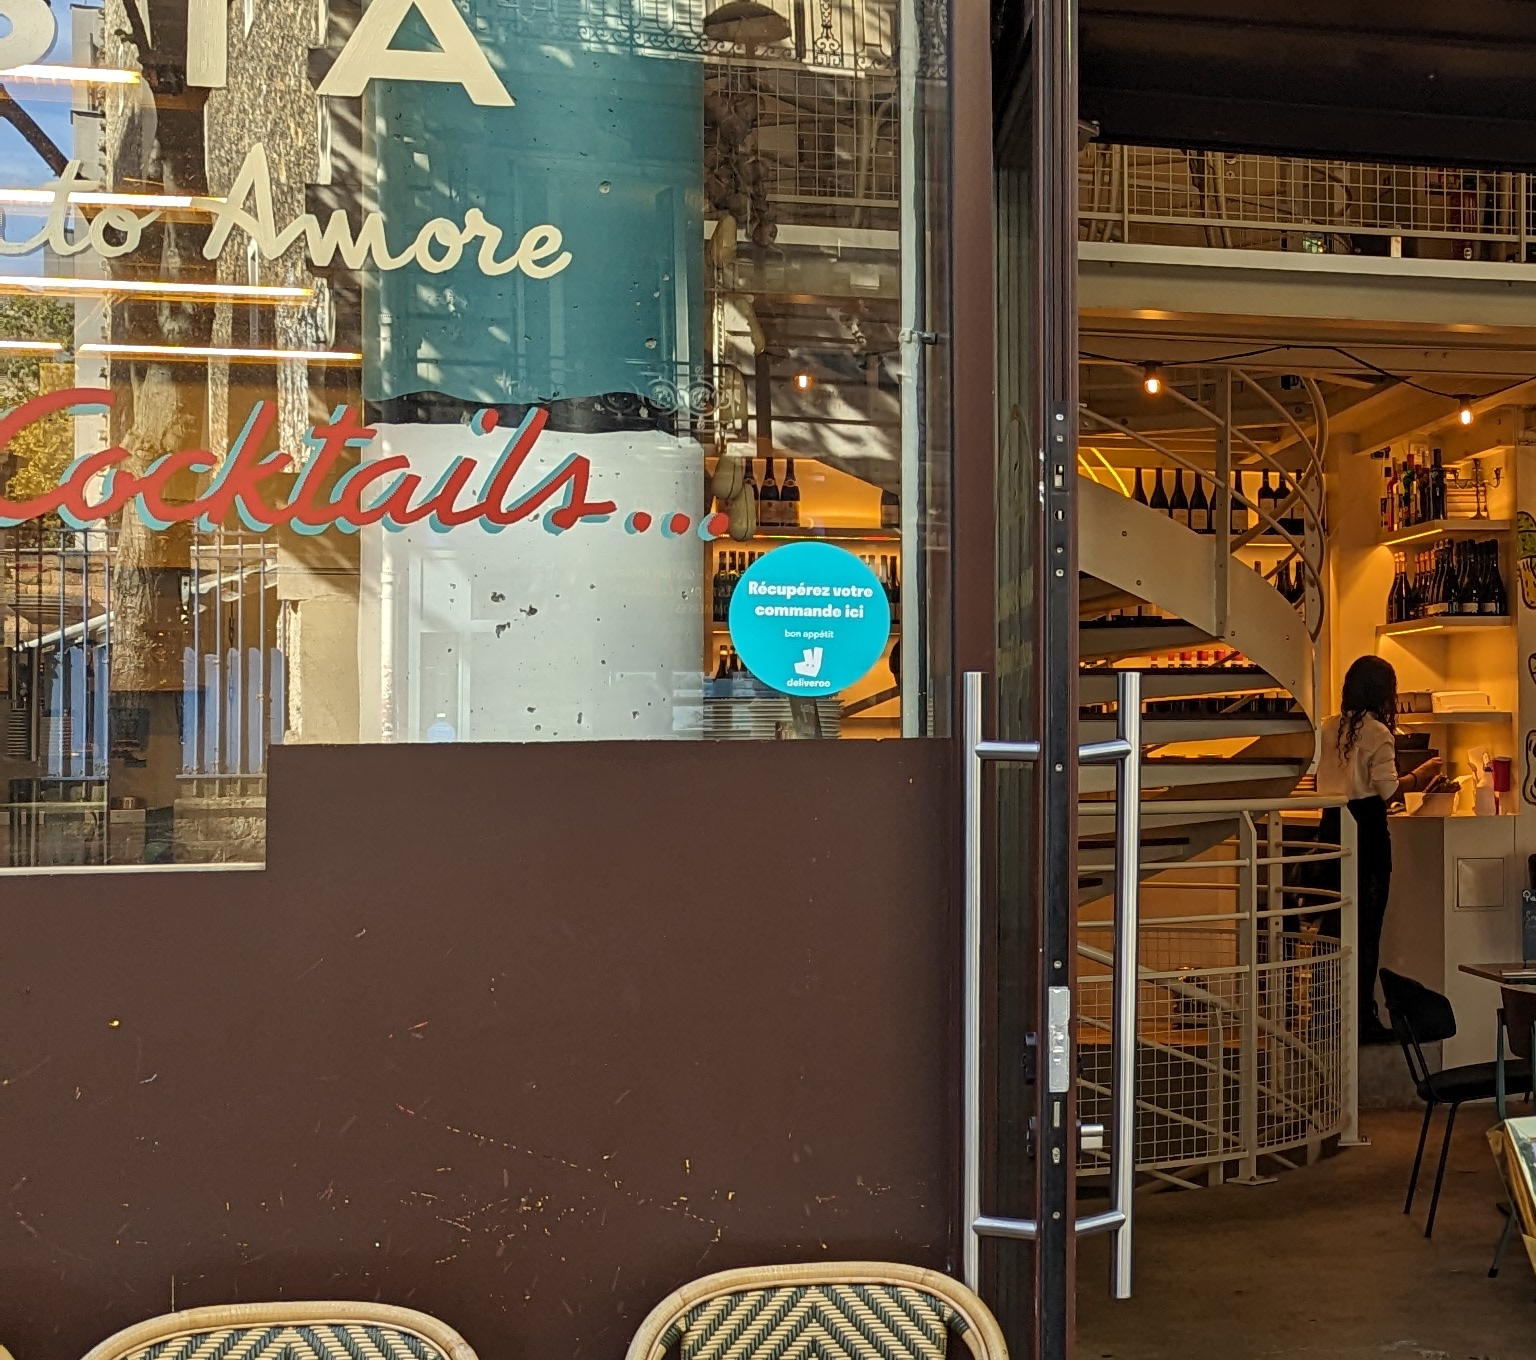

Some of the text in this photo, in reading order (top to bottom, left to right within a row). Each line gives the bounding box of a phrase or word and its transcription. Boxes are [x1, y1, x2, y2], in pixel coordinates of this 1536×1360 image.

[192, 142, 573, 280] Amore
[748, 580, 874, 600] Récupérez votre
[754, 603, 864, 619] commande ici
[784, 628, 834, 640] bon appétit
[786, 677, 831, 688] deliveroo
